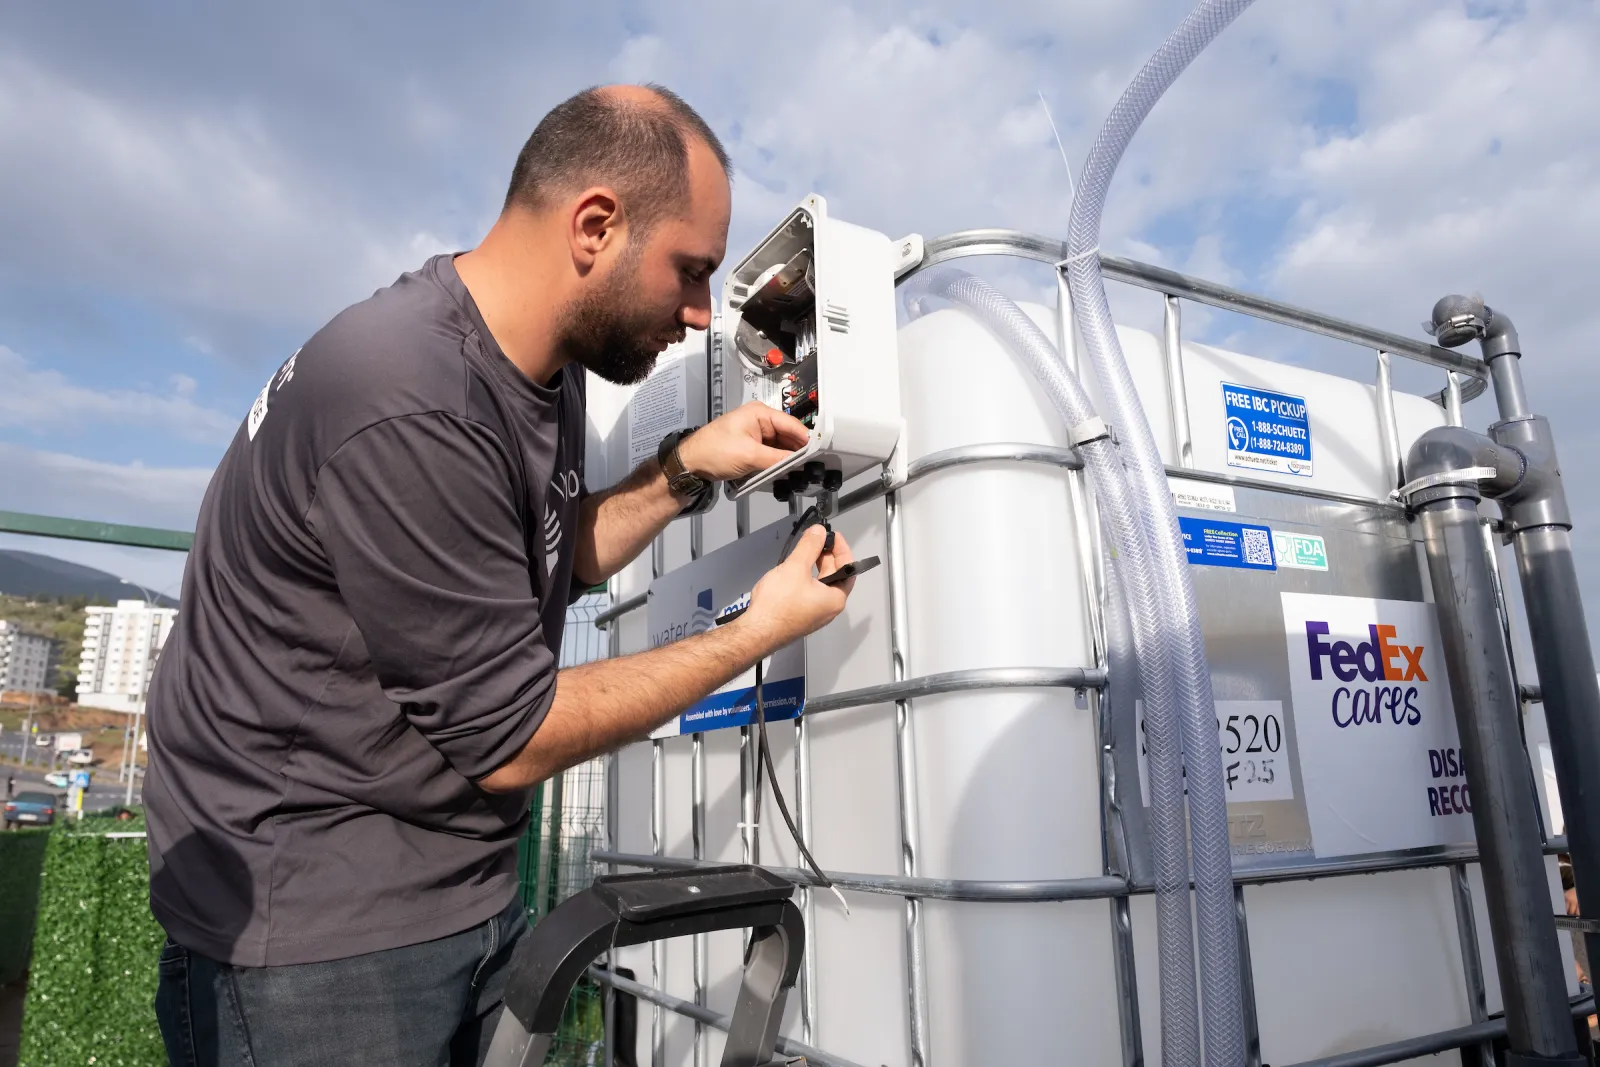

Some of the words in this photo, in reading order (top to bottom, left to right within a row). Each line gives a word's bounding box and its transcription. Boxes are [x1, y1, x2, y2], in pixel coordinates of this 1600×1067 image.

[1225, 391, 1251, 409] FREE
[1252, 396, 1270, 412] IBC
[1270, 400, 1306, 418] PICKUP
[1251, 420, 1306, 439] 1-888-SCHUETZ
[1250, 437, 1304, 456] (1-888-724-8389)
[1294, 539, 1324, 556] FDA
[652, 620, 688, 646] water
[1305, 620, 1429, 682] FedEx
[705, 709, 714, 719] with
[713, 708, 722, 717] love
[722, 707, 728, 717] by
[1332, 686, 1421, 728] cares
[1216, 714, 1281, 753] 520
